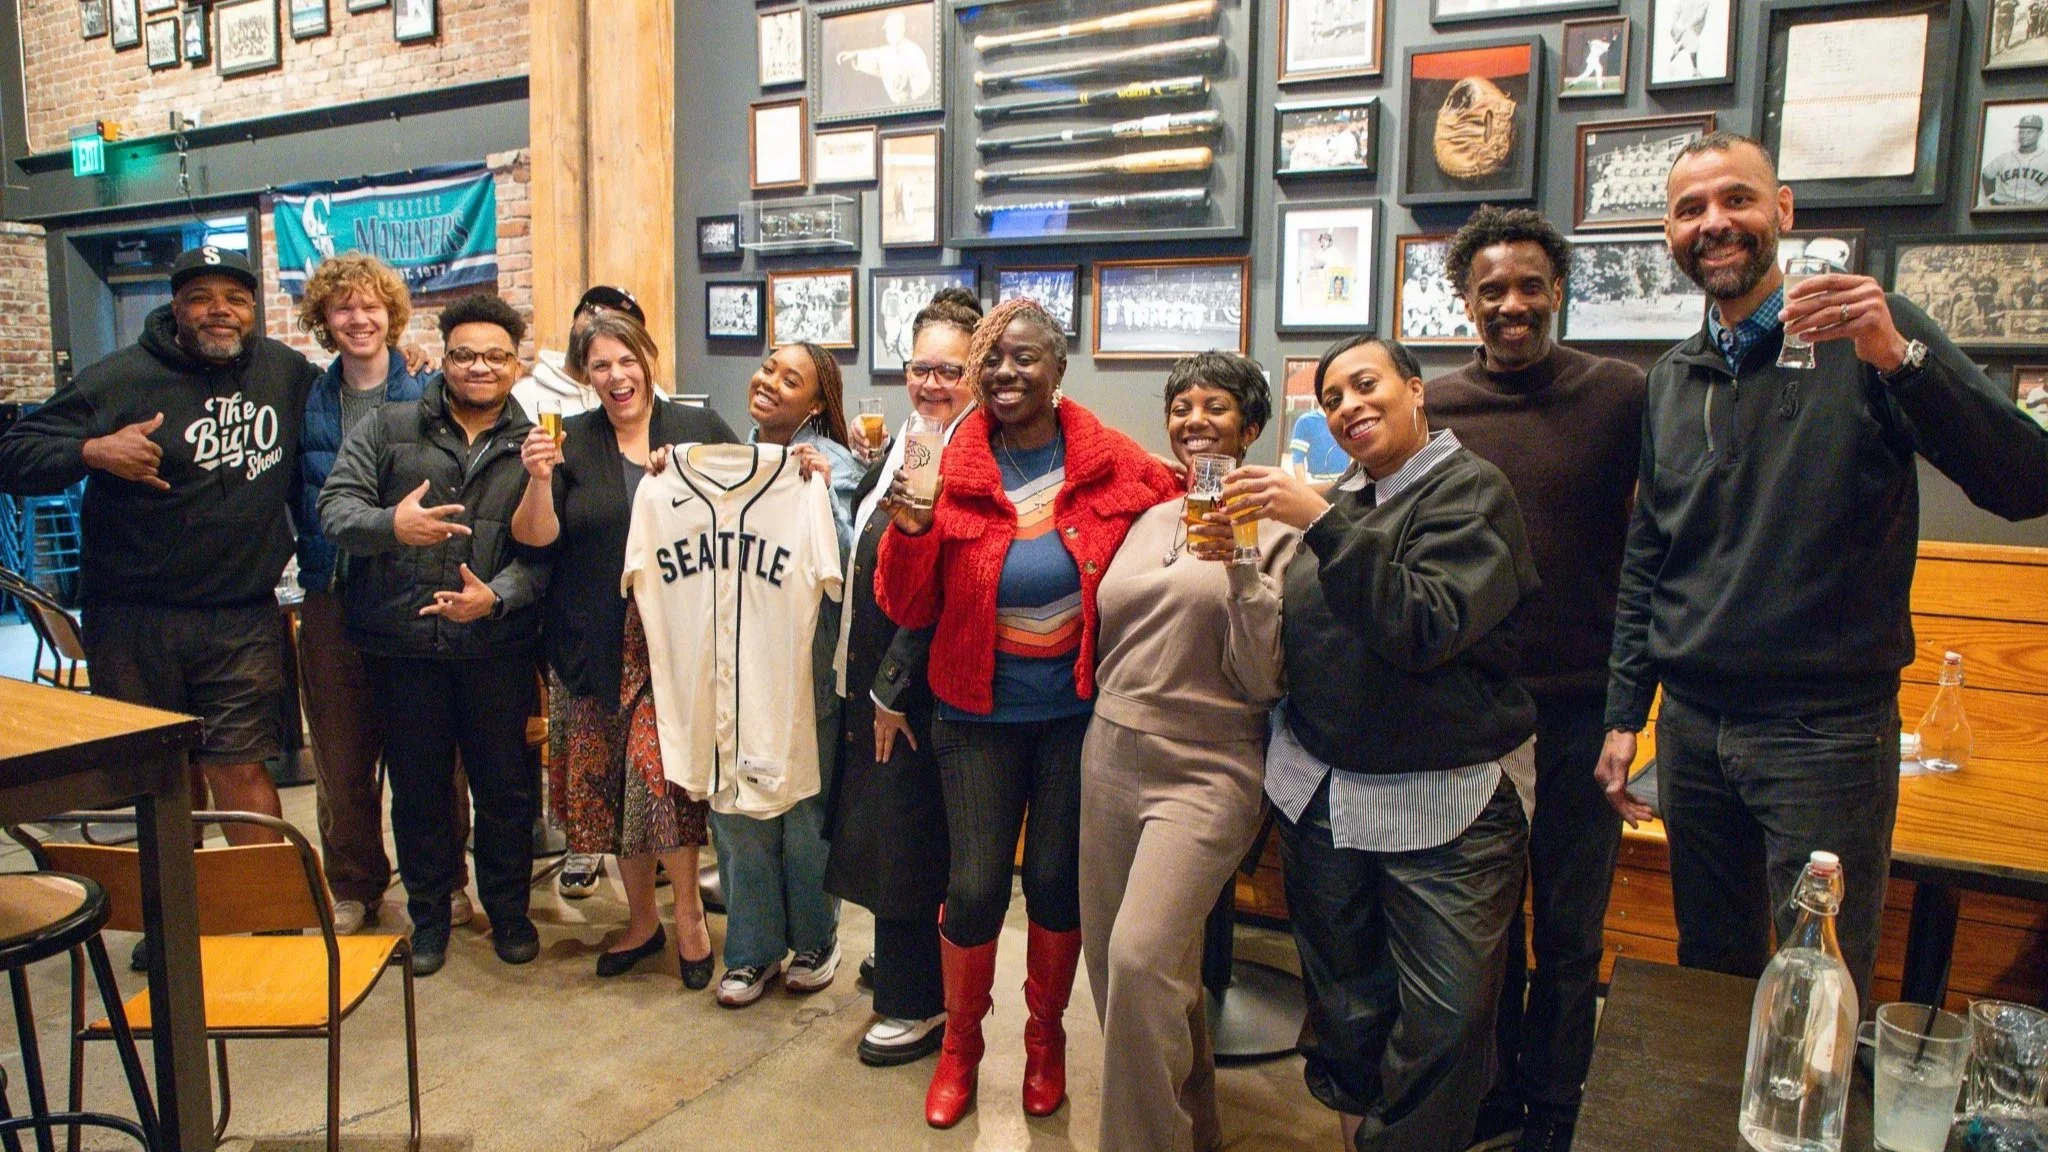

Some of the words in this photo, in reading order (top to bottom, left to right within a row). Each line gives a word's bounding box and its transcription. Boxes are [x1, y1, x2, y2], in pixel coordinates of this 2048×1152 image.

[377, 195, 441, 218] SEATTLE
[354, 210, 470, 261] MARINERS
[203, 246, 221, 265] S
[416, 263, 447, 279] 1977
[204, 392, 257, 427] The
[246, 446, 283, 481] Show
[656, 531, 791, 589] SEATTLE
